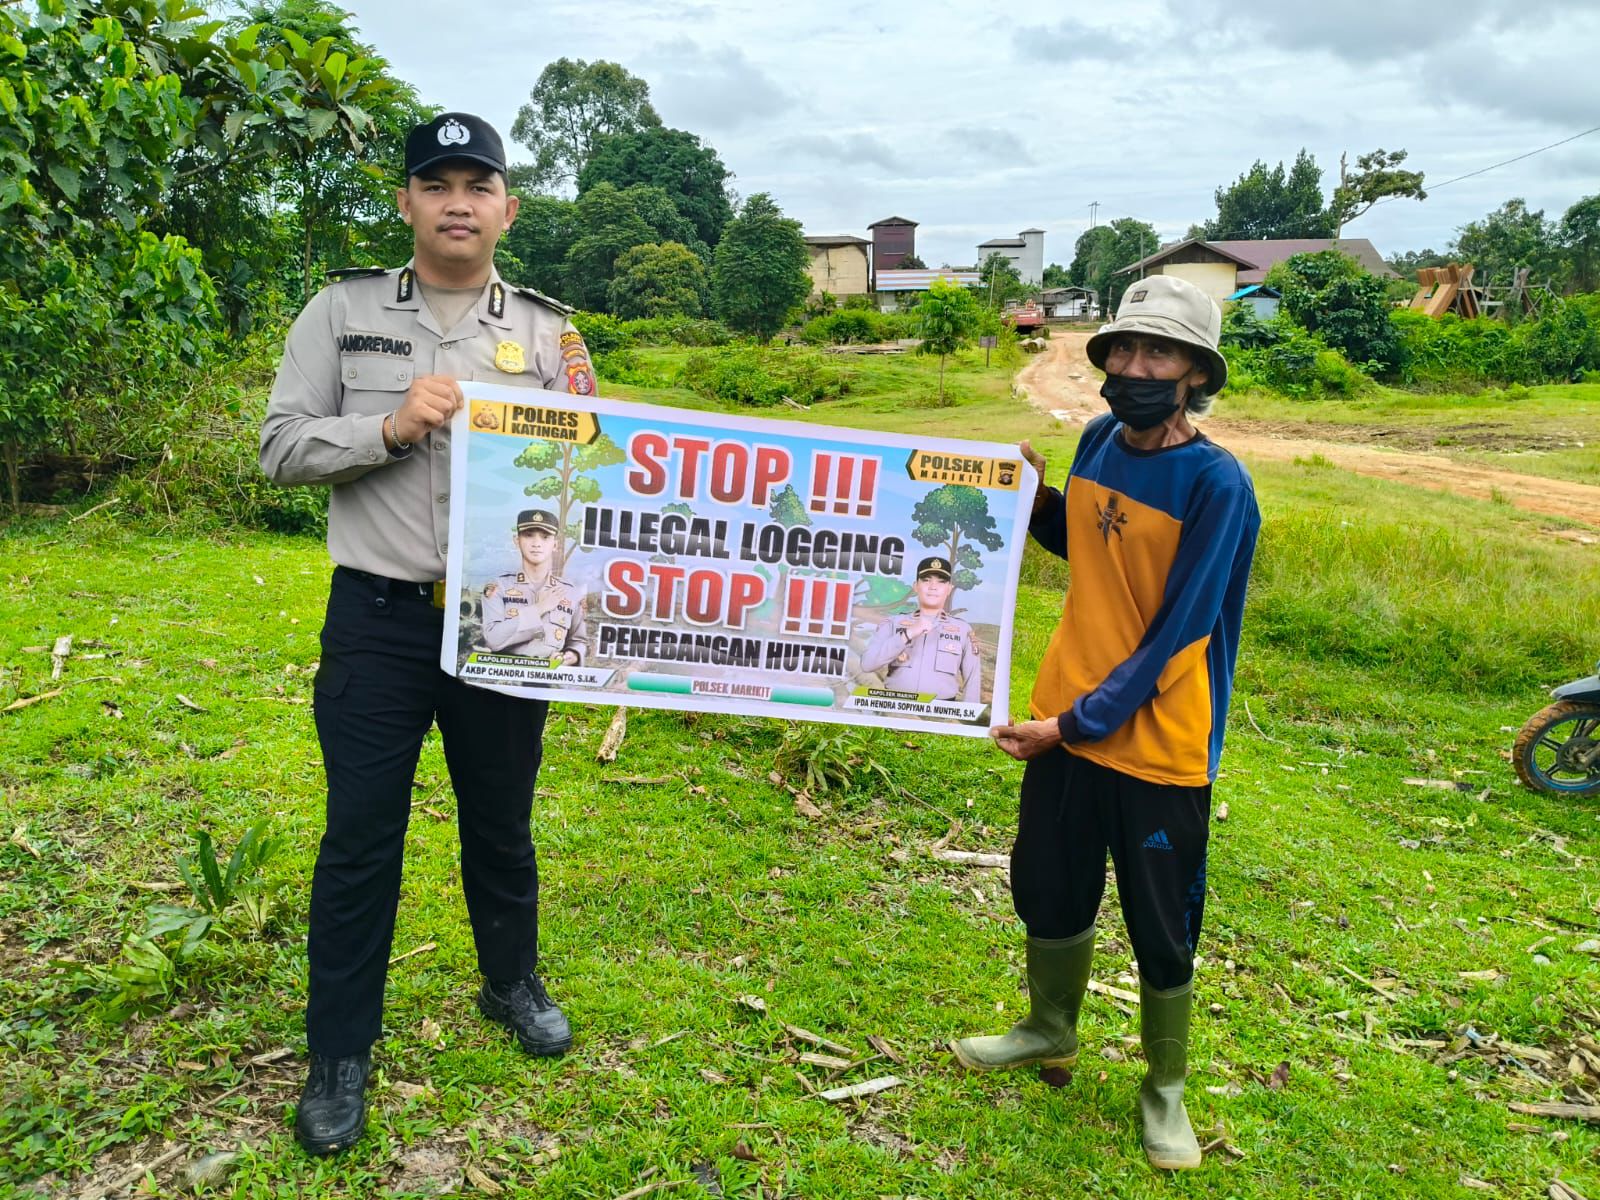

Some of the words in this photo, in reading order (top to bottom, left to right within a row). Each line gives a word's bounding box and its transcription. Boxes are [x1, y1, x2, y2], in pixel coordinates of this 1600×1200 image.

[512, 406, 579, 427] POLRES
[511, 422, 577, 440] KATINGAN
[920, 455, 984, 474] POLSEK
[628, 433, 790, 507] STOP
[810, 453, 878, 517] !!!
[920, 470, 983, 484] MARIKIT
[583, 507, 730, 559] ILLEGAL
[741, 523, 905, 576] LOGGING
[606, 560, 766, 627] STOP
[784, 578, 851, 636] !!!
[557, 604, 573, 615] OLRI
[939, 633, 961, 641] POLRI
[599, 625, 760, 669] PENEBANGAN
[765, 641, 846, 676] HUTAN
[477, 655, 513, 665] KAPOLRES
[514, 658, 550, 667] KATINGAN
[465, 665, 486, 675] AKBP
[488, 667, 525, 678] CHANDRA
[527, 669, 576, 683] ISMAWANTO,
[692, 680, 729, 694] POLSEK
[731, 683, 771, 698] MARIKIT
[869, 690, 896, 698] KAPOLSEK
[854, 698, 869, 706] IPDA
[870, 699, 896, 709] HENDRA
[897, 702, 925, 712] SOPIYAN
[926, 705, 933, 713] D.
[934, 706, 962, 718] MUNTHE,
